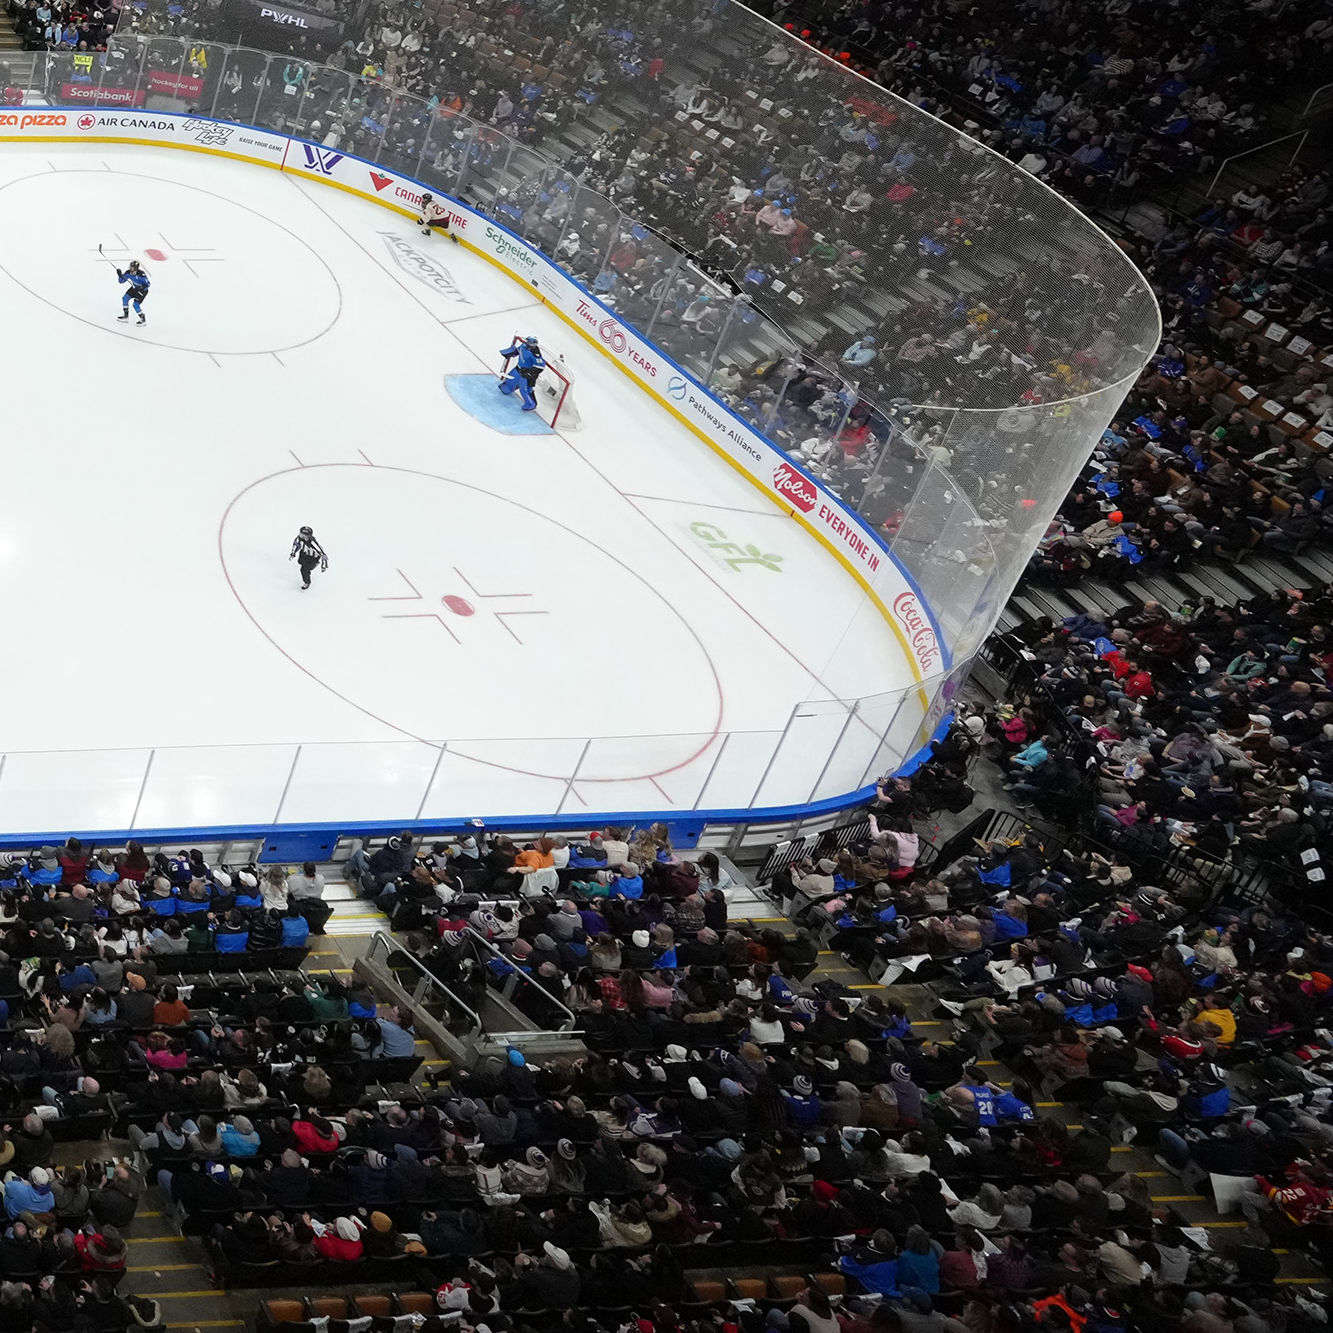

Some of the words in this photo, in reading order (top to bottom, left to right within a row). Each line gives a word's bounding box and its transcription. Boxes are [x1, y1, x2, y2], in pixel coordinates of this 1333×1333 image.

[260, 7, 309, 28] PWHL
[151, 77, 178, 90] hockey
[70, 87, 133, 102] Scotiabank
[20, 114, 67, 130] pizza
[97, 117, 119, 129] AIR
[121, 118, 175, 132] CANADA
[182, 119, 234, 138] Hockey
[239, 137, 254, 145] RAISE
[268, 144, 283, 152] GAME
[448, 210, 468, 229] TIRE
[485, 226, 538, 267] Schneider
[376, 230, 474, 306] JACKPOTCITY
[505, 252, 535, 276] Electric
[576, 298, 598, 328] Tims
[598, 318, 628, 354] 60
[627, 348, 657, 379] YEARS
[688, 395, 727, 434] Pathways
[727, 429, 763, 463] Alliance
[773, 465, 819, 509] Molson
[818, 504, 870, 562] EVERYONE
[867, 558, 880, 573] IN
[892, 591, 939, 673] Coca-Cola
